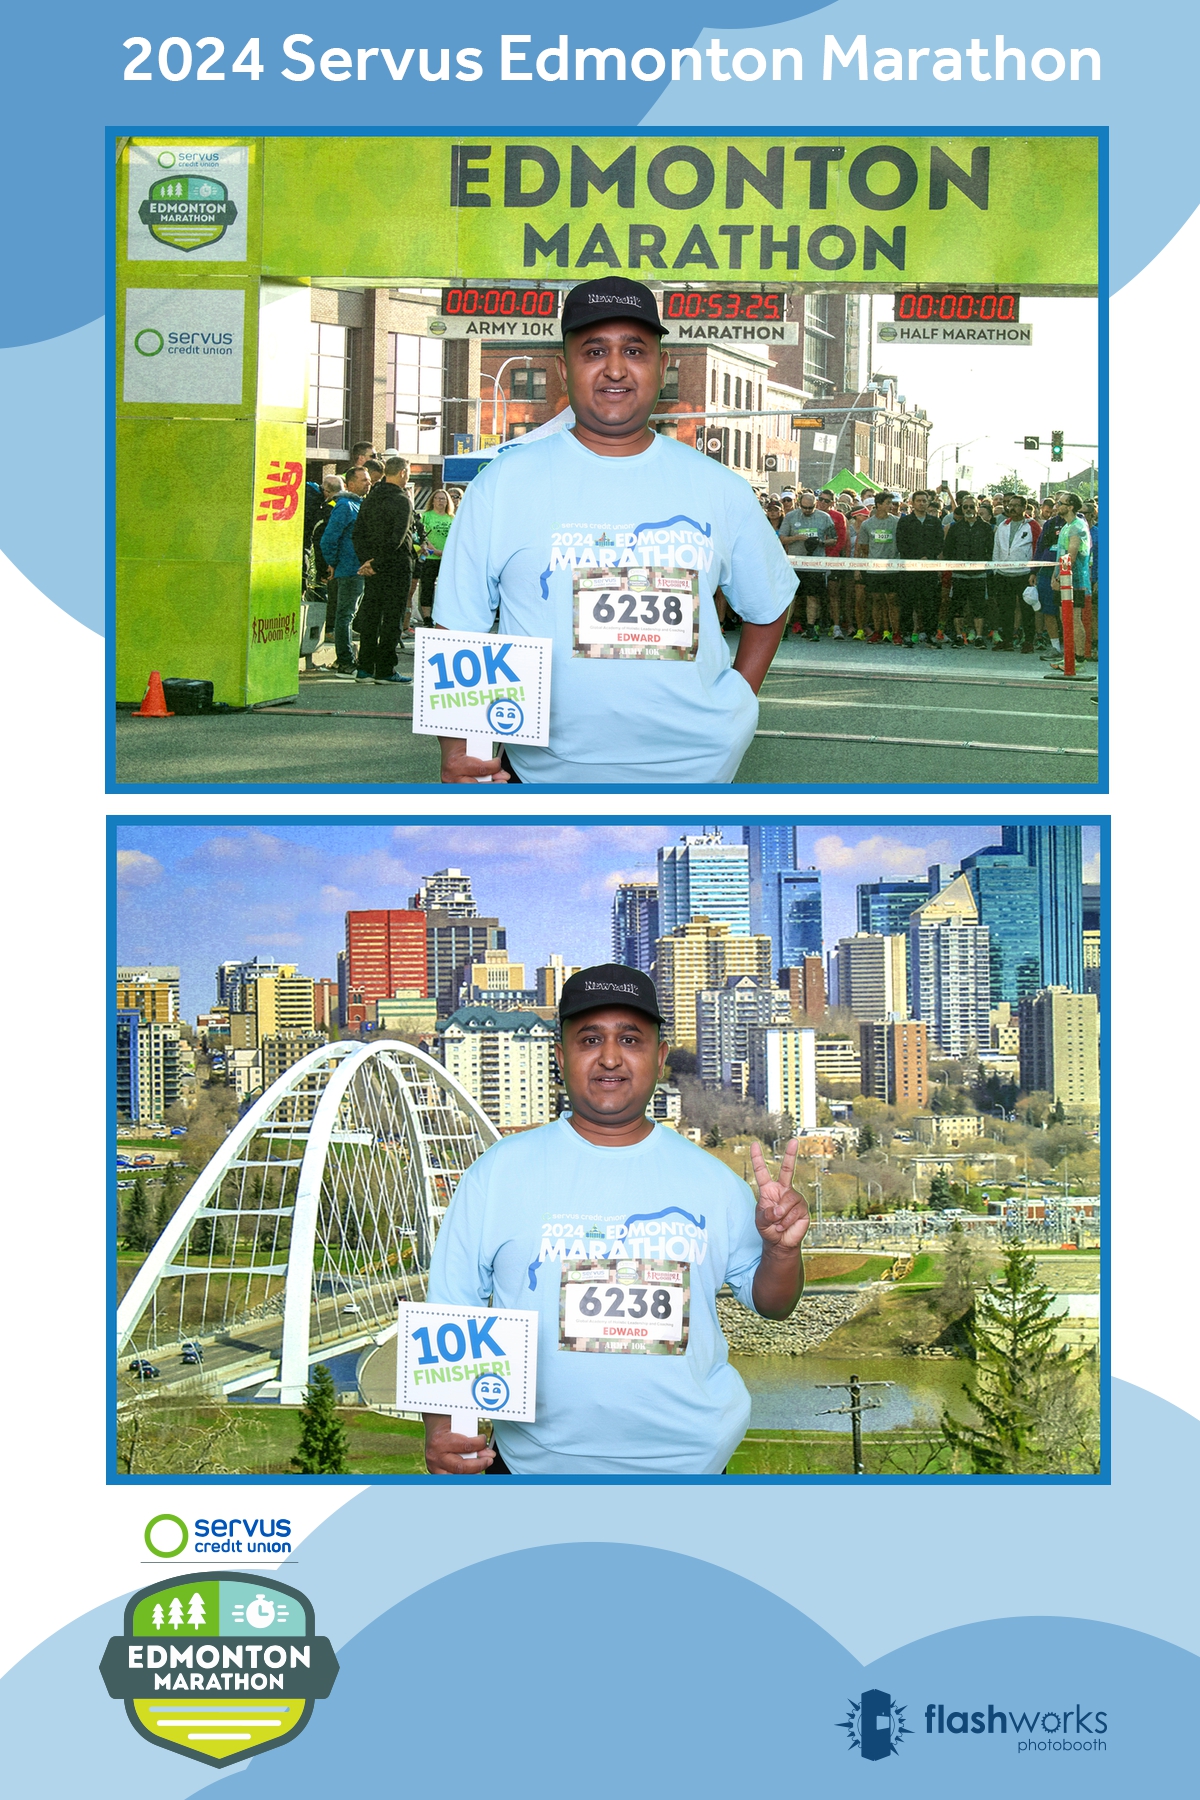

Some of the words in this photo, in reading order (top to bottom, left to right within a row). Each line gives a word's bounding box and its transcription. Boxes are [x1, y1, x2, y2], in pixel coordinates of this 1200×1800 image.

[178, 152, 219, 161] servus
[178, 160, 202, 168] credit
[450, 144, 990, 211] EDMONTON
[150, 202, 227, 214] EDMONTON
[160, 214, 215, 223] MARATHON
[523, 223, 906, 271] MARATHON
[466, 321, 518, 336] ARMY
[522, 322, 554, 336] 10K
[678, 325, 785, 340] MARATHON
[900, 328, 939, 340] HALF
[942, 329, 1031, 341] MARATHON
[168, 331, 233, 345] servus
[168, 345, 200, 355] credit
[202, 347, 233, 356] union
[589, 522, 612, 530] credit
[551, 532, 595, 547] 2024
[615, 529, 714, 550] EDMONTON
[550, 544, 714, 574] MARATHON
[593, 593, 683, 626] 6238
[617, 633, 661, 643] EDWARD
[428, 643, 521, 690] 10K
[429, 686, 526, 710] FINISHER!
[580, 1212, 603, 1221] credit
[541, 1223, 584, 1238] 2024
[606, 1221, 708, 1243] EDMONTON
[538, 1235, 708, 1266] MARATHON
[579, 1286, 672, 1320] 6238
[603, 1327, 649, 1337] EDWARD
[411, 1316, 506, 1365] 10K
[605, 1341, 629, 1349] ARMY
[631, 1342, 646, 1350] 10K
[413, 1360, 511, 1386] FINISHER!
